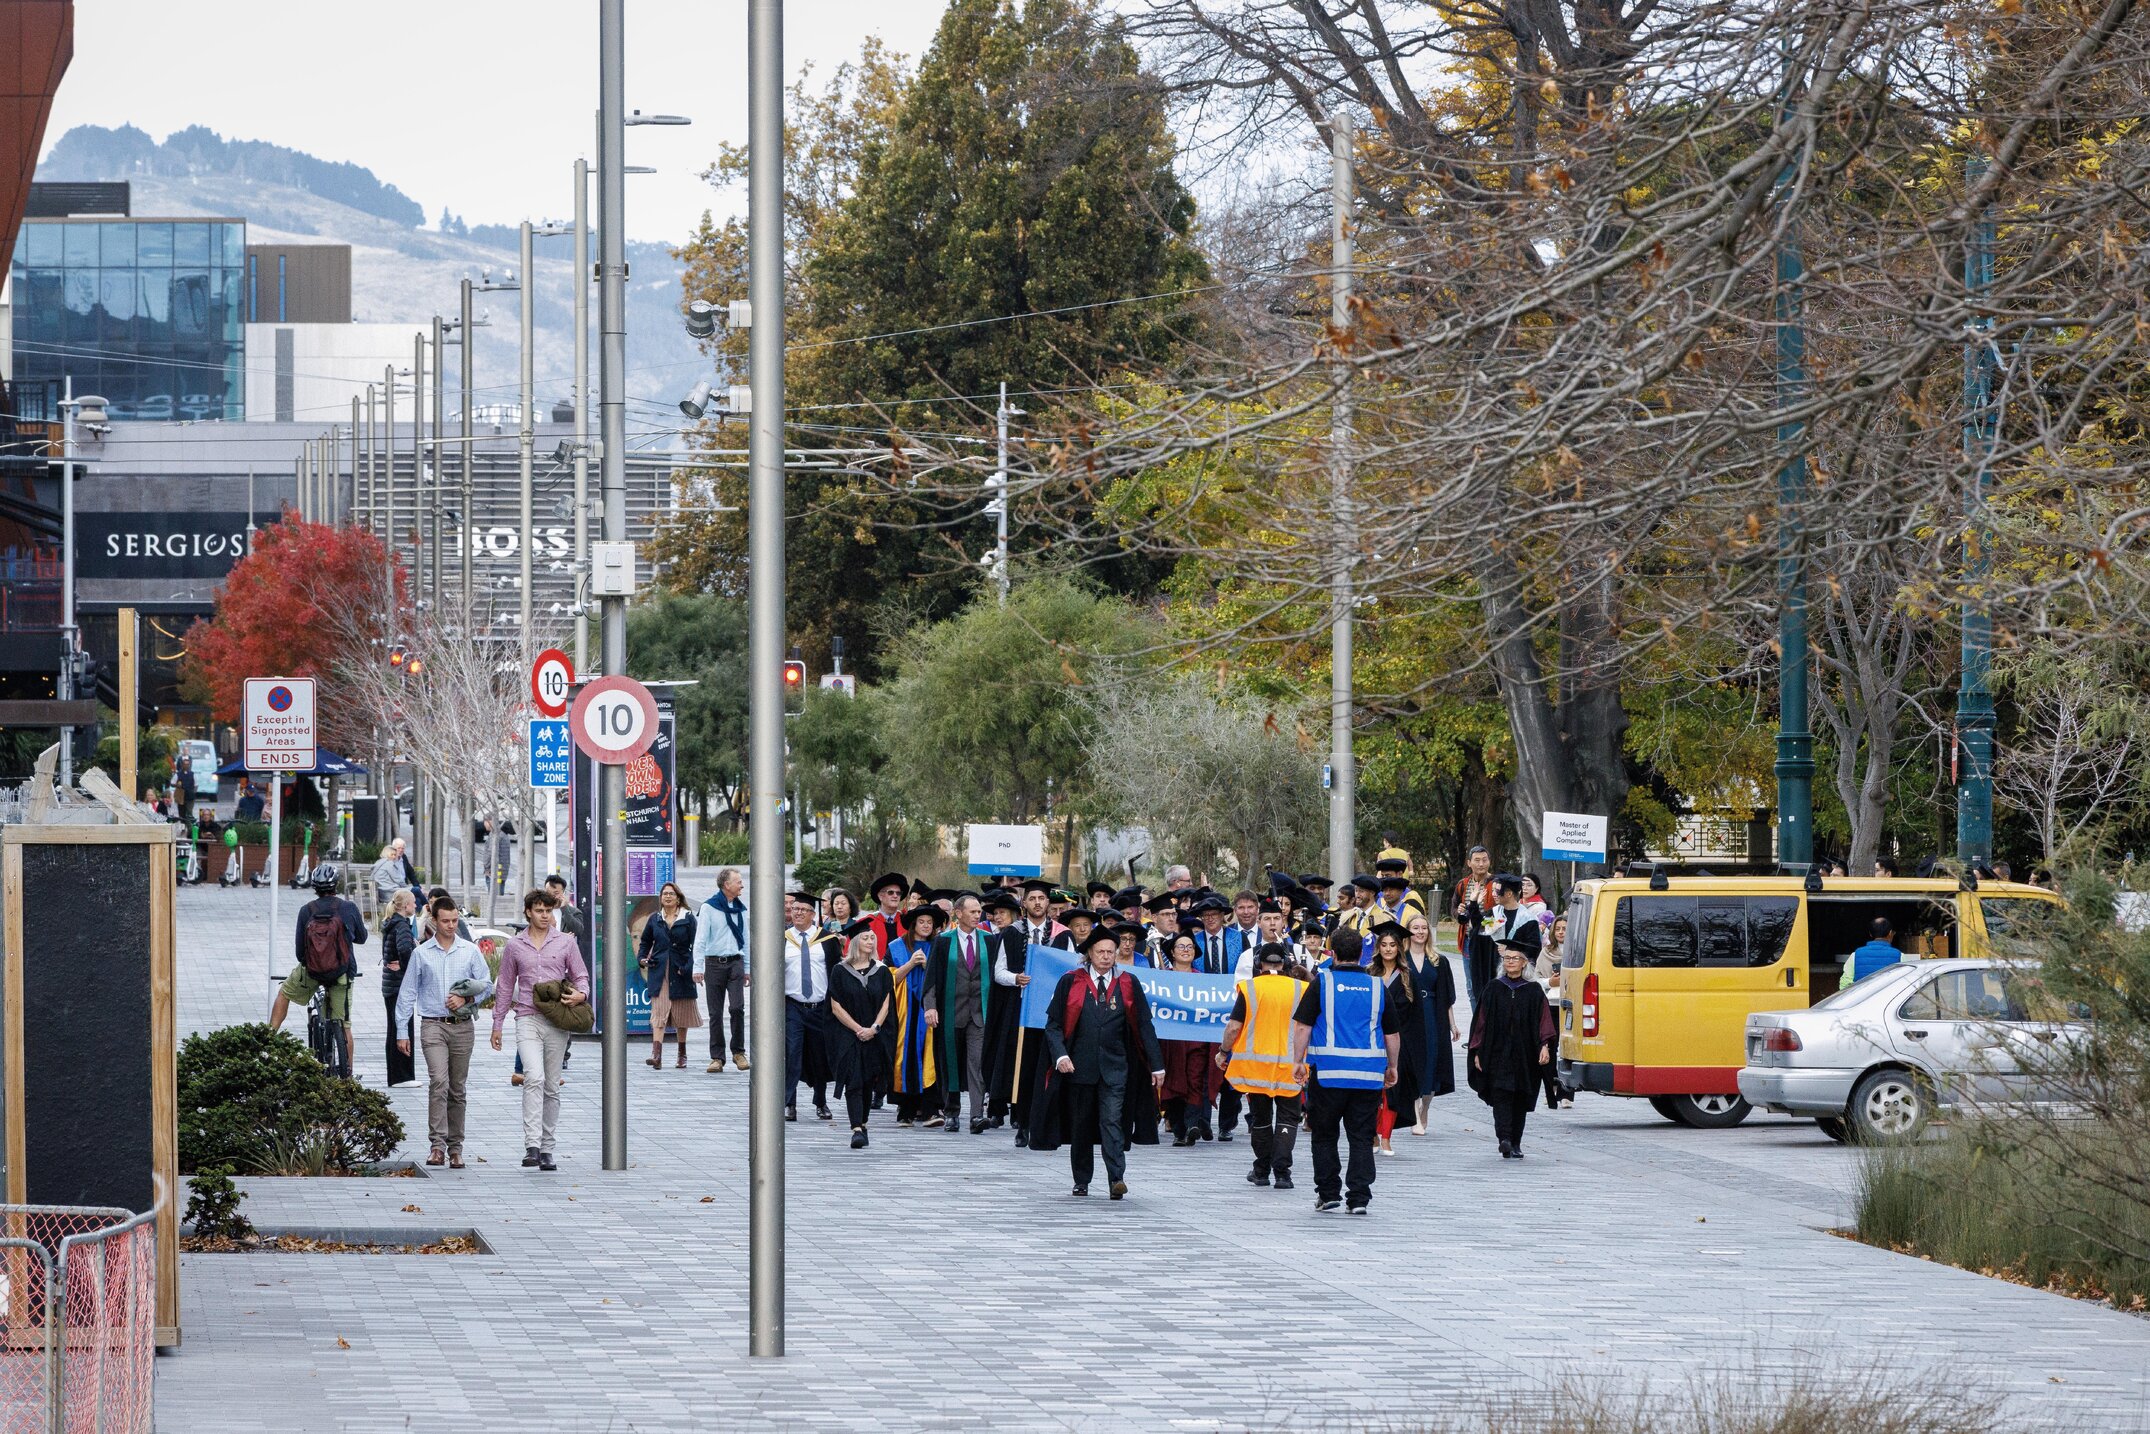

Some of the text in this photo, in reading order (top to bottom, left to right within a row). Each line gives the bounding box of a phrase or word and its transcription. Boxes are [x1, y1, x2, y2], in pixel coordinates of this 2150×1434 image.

[106, 533, 244, 557] SERGIOS
[457, 526, 569, 558] BOSS
[544, 671, 563, 696] 10
[256, 715, 305, 725] Except in
[598, 704, 633, 735] 10
[251, 726, 311, 736] Signposted
[265, 737, 296, 746] Areas
[261, 753, 300, 764] ENDS
[543, 773, 567, 783] ZONE
[626, 768, 655, 785] OWN
[632, 816, 650, 824] HALL
[1560, 821, 1581, 829] Master
[1556, 836, 1592, 846] Computing
